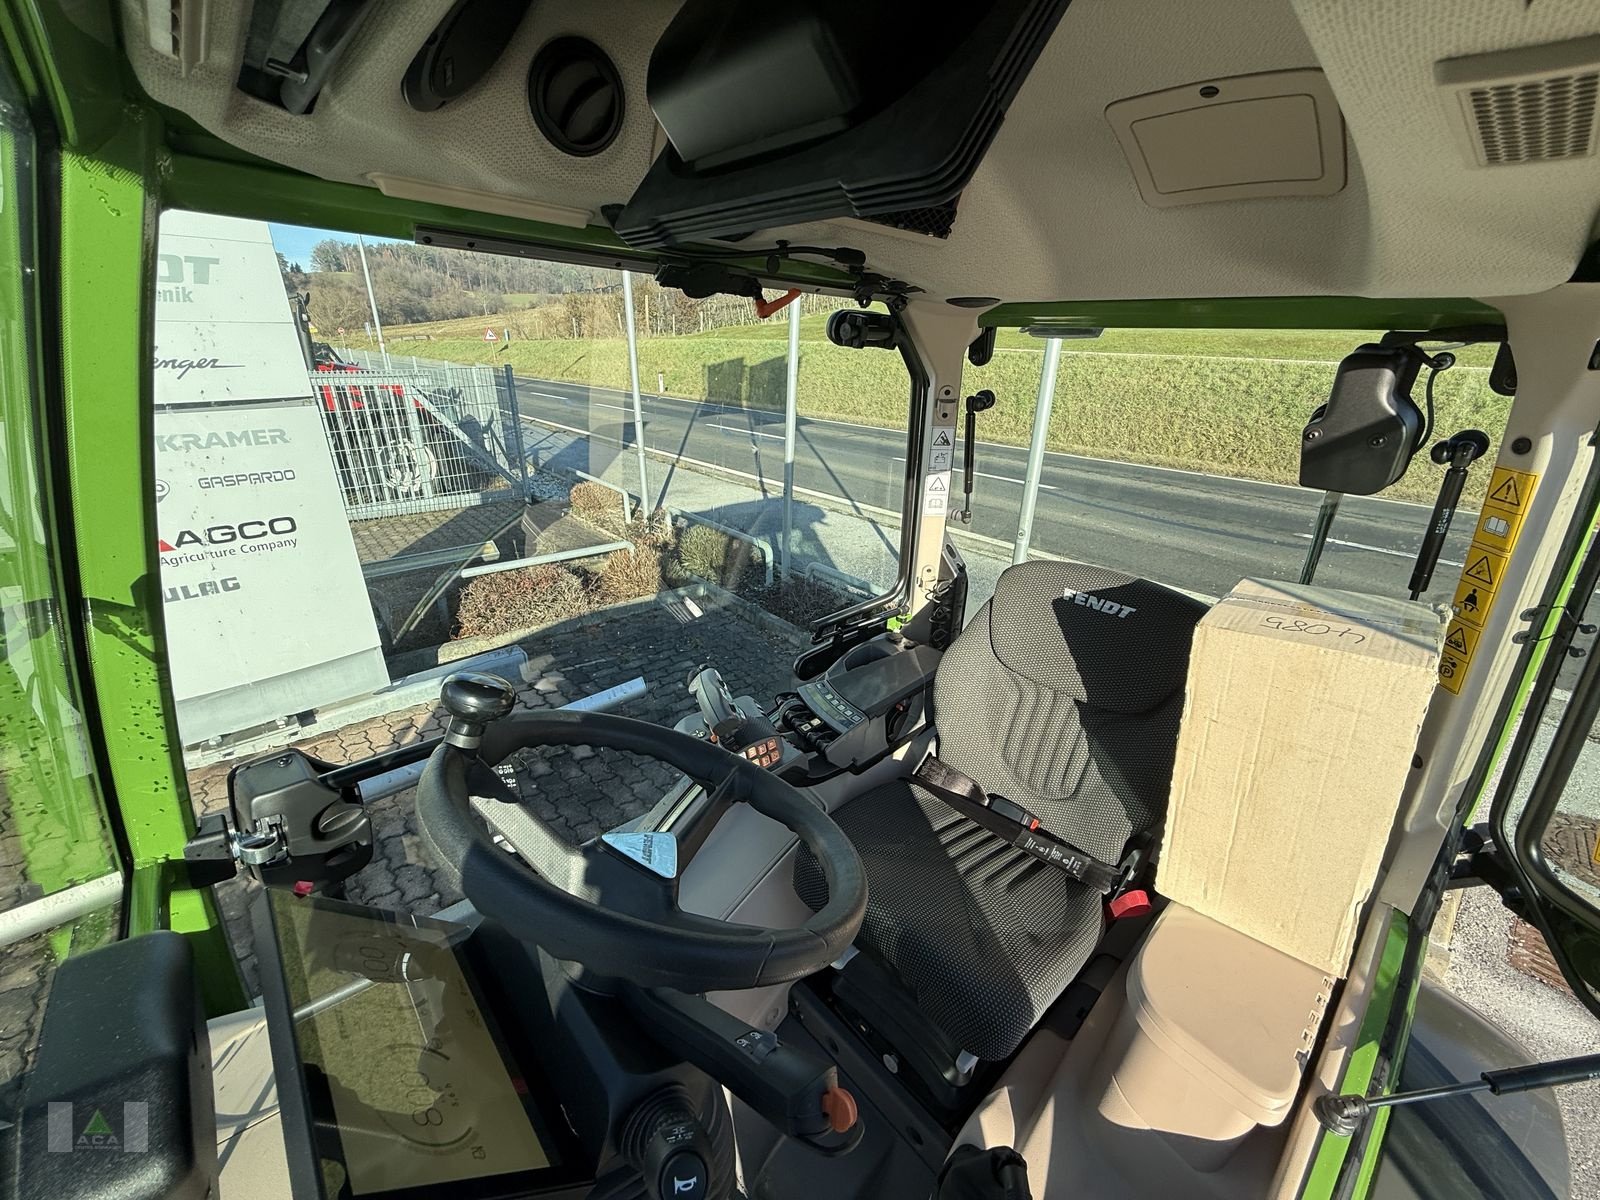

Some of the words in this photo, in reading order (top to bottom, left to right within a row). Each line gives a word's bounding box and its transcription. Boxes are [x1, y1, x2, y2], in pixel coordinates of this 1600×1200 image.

[157, 287, 194, 303] nik
[156, 428, 290, 452] KRAMER
[198, 469, 296, 489] GASPARDO
[175, 516, 297, 548] AGCO
[240, 537, 297, 555] Company
[1063, 587, 1137, 619] FENDT
